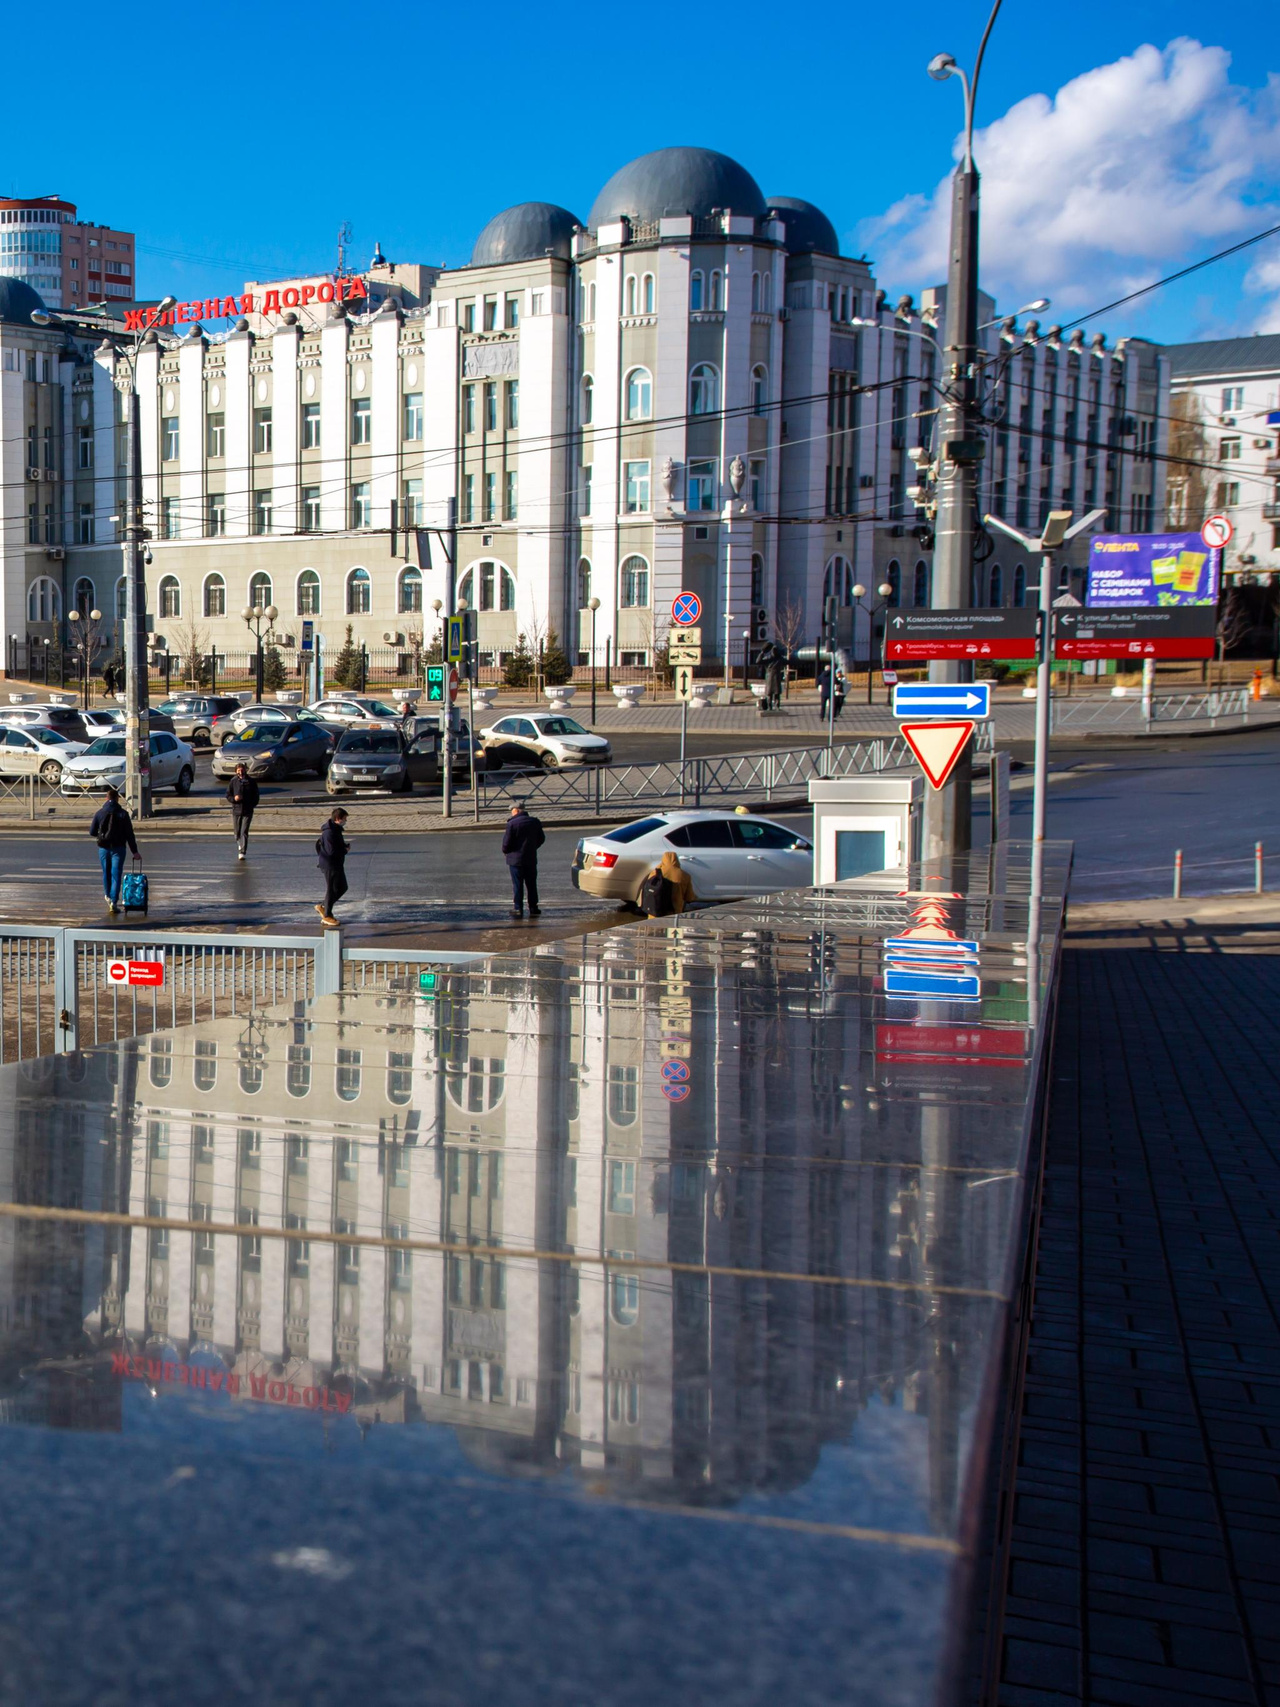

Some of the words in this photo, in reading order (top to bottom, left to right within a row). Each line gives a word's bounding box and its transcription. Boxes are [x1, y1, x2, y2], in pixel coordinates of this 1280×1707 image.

[123, 293, 254, 331] ЖЕЛЕЗНАЯ
[262, 277, 368, 316] ДОРОГА
[1102, 542, 1139, 552] ЛЕНТА
[1091, 570, 1124, 578] НАБОР
[1100, 579, 1151, 587] СЕМЕНАМИ
[1098, 588, 1143, 597] ПОДАРОК
[906, 615, 968, 623] Комсомольская
[428, 669, 442, 681] 09
